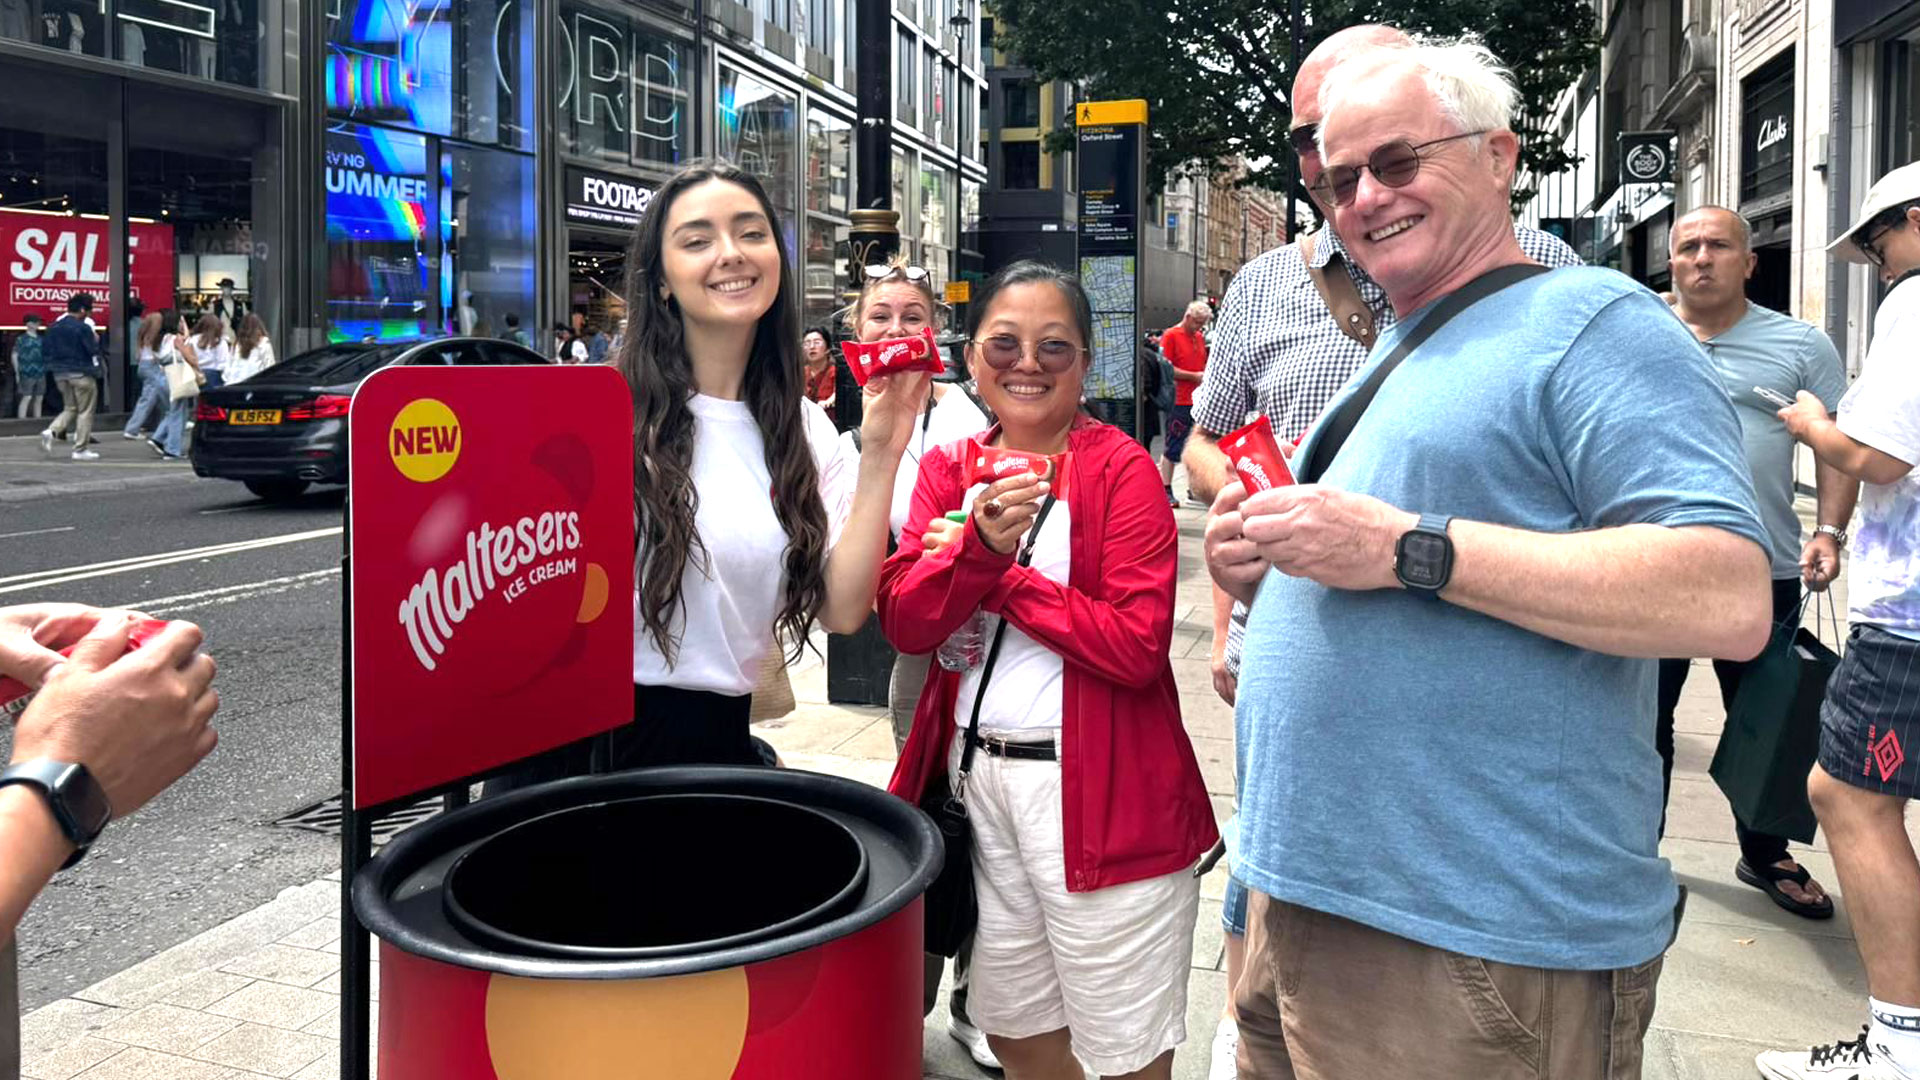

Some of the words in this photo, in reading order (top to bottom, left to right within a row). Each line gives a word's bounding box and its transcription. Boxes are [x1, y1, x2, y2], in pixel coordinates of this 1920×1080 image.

[1757, 115, 1787, 152] Clarks
[1634, 159, 1658, 167] BODY
[1636, 165, 1657, 173] SHOP
[393, 425, 459, 456] NEW
[399, 510, 580, 671] Maltesers
[503, 577, 528, 604] ICE
[529, 558, 577, 585] CREAM
